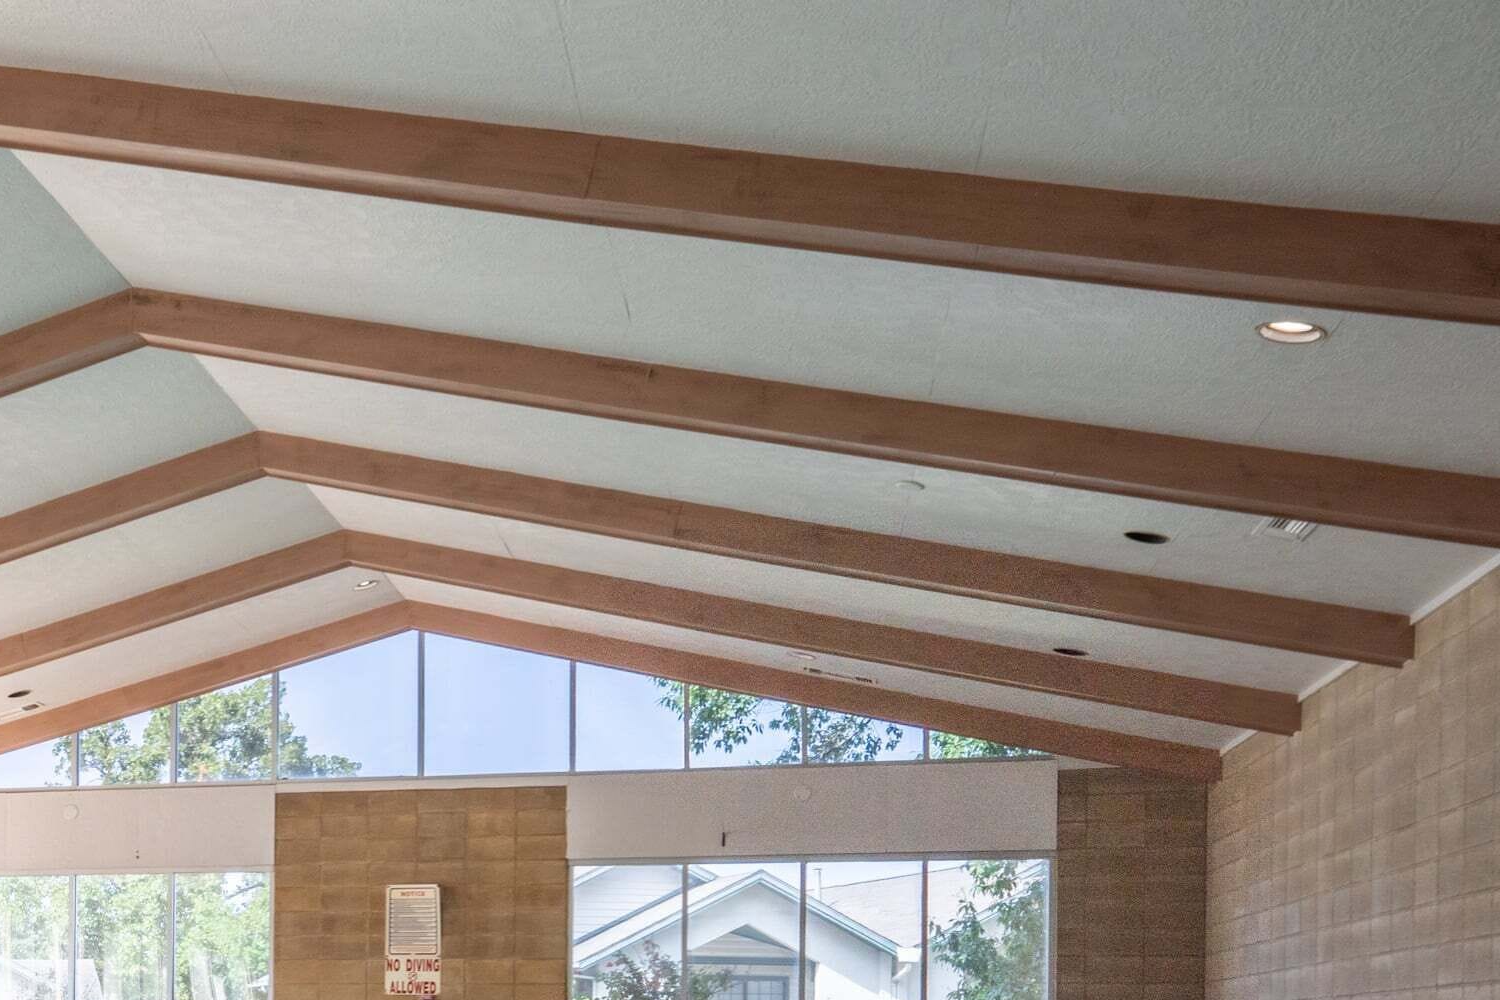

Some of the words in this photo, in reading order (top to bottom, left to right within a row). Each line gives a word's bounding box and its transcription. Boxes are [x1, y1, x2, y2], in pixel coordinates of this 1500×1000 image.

[387, 959, 400, 972] NO
[406, 959, 440, 972] DIVING
[390, 981, 436, 994] ALLOWED
